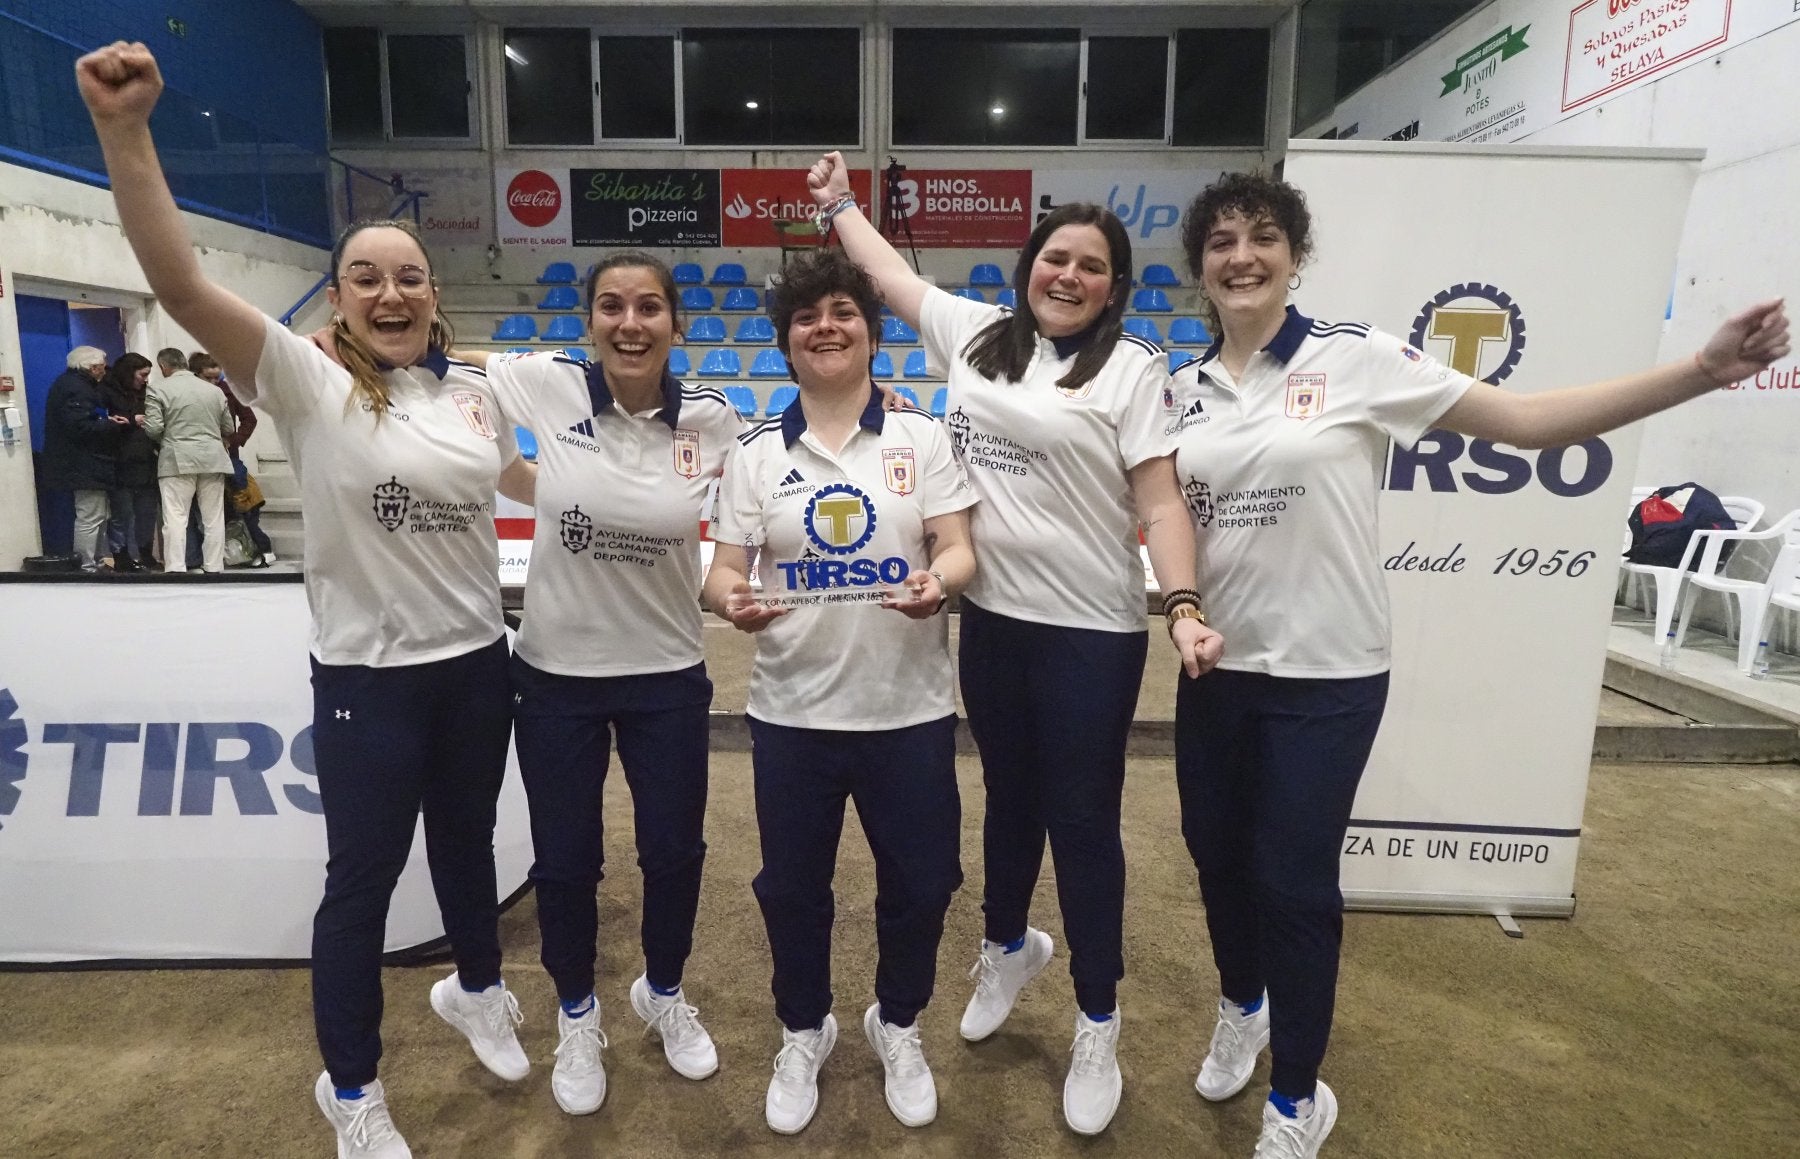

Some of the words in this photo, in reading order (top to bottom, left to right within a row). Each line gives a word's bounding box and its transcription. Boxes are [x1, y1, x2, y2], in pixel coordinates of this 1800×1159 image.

[1584, 21, 1634, 55] Sobaos
[1640, 0, 1690, 26] Pasieg
[1596, 55, 1606, 69] y
[1611, 14, 1687, 59] Quesadas
[1611, 46, 1665, 82] SELAYA
[1465, 96, 1490, 117] POTES
[584, 171, 707, 201] Sibarita's
[926, 179, 982, 194] HNOS.
[756, 198, 868, 220] Santar
[926, 197, 1023, 213] BORBOLLA
[425, 217, 480, 232] Sociedad
[628, 206, 698, 232] pizzería
[540, 237, 567, 245] SABOR
[556, 433, 601, 454] CAMARGO
[971, 446, 981, 455] DE
[982, 446, 1030, 466] CAMARG
[970, 456, 1028, 476] DEPORTES
[772, 484, 816, 500] CAMARGO
[1216, 485, 1306, 503] AYUNTAMIENTO
[411, 500, 490, 512] AYUNTAMIENTO
[1218, 508, 1228, 516] DE
[1229, 501, 1287, 516] CAMARGO
[410, 513, 422, 521] DE
[424, 511, 476, 525] CAMARGO
[1218, 515, 1278, 528] DEPORTES
[410, 523, 469, 534] DEPORTES
[596, 530, 684, 546] AYUNTAMIENTO
[594, 541, 606, 549] DE
[608, 541, 667, 556] CAMARGO
[593, 552, 655, 567] DEPORTES
[1384, 541, 1467, 573] desde
[1493, 547, 1597, 578] 1956
[777, 556, 910, 591] TIRSO
[765, 599, 787, 607] COPA
[42, 721, 327, 817] TIR
[1387, 838, 1415, 858] DE
[1427, 839, 1459, 860] UN
[1469, 841, 1550, 864] EQUIPO
